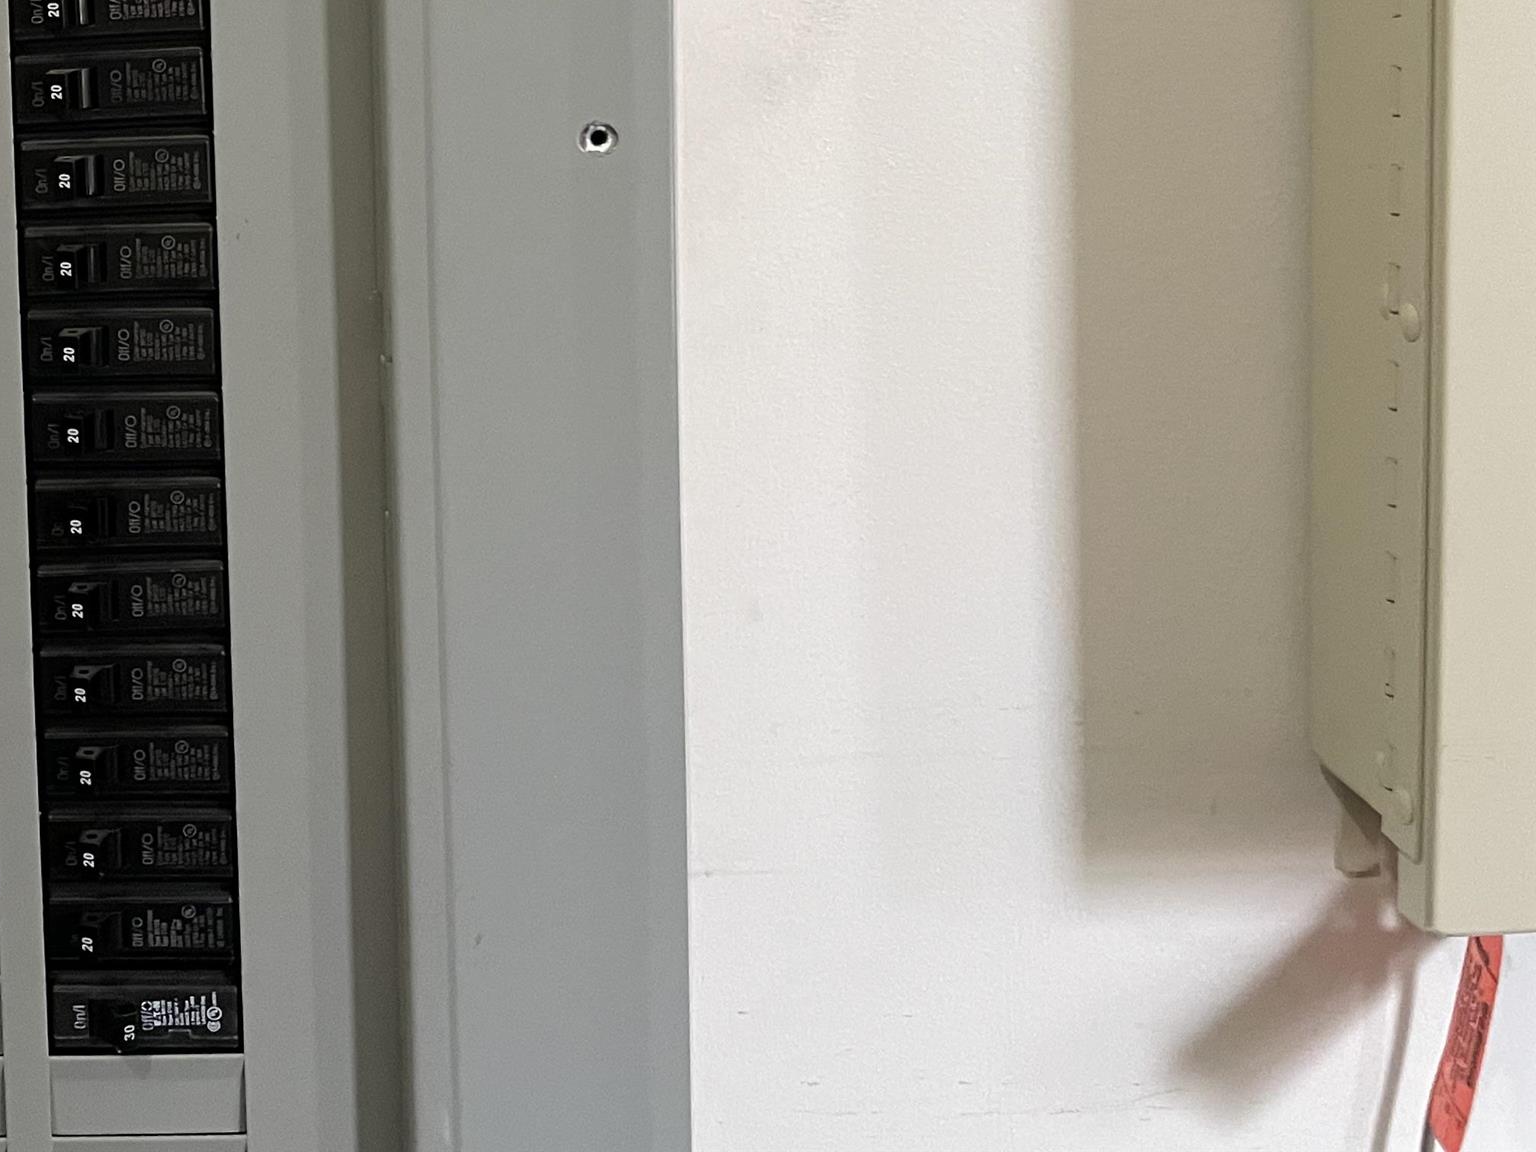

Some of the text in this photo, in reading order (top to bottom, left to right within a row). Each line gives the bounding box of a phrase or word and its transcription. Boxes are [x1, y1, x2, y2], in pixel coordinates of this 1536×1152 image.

[48, 3, 59, 17] 20
[51, 85, 62, 99] 20
[59, 174, 70, 188] 20
[60, 262, 71, 276] 20
[64, 348, 74, 362] 20
[68, 429, 79, 443] 20
[70, 520, 82, 533] 20
[72, 604, 83, 618] 20
[75, 688, 86, 702] 20
[80, 771, 91, 784] 20
[83, 853, 94, 867] 20
[82, 938, 92, 952] 20
[124, 1025, 134, 1040] 30
